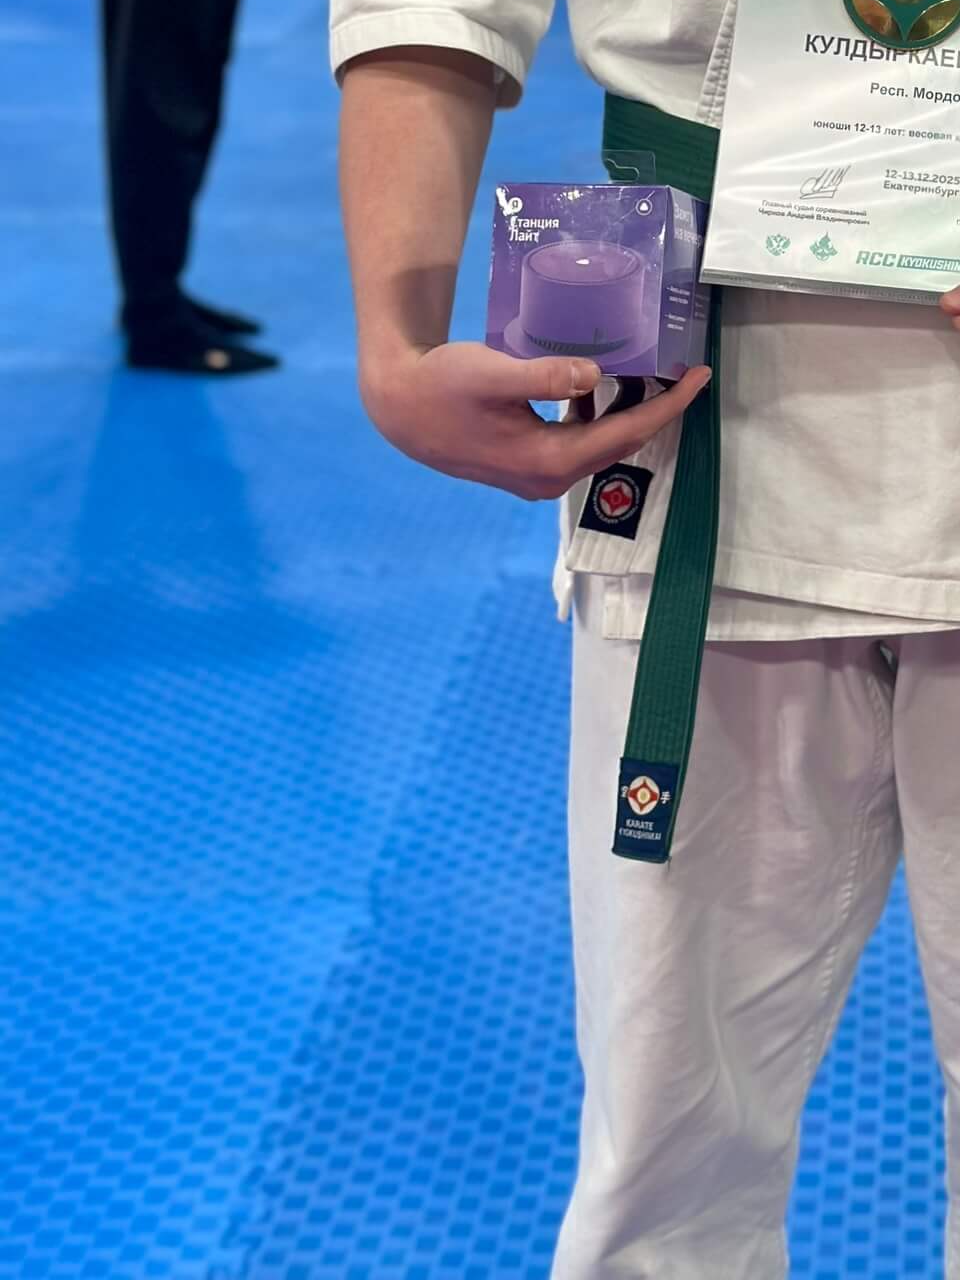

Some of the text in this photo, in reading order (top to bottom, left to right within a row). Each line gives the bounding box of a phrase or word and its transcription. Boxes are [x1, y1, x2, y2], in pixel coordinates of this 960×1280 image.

[870, 82, 909, 98] Респ.
[813, 120, 851, 132] юноши
[854, 122, 881, 135] 12-13
[884, 126, 905, 138] лет:
[908, 129, 952, 141] весовая
[884, 168, 960, 186] 12-13.12.2025
[883, 180, 960, 198] Екатеринбург
[510, 216, 560, 230] Станция
[509, 227, 540, 243] Лайт
[855, 251, 897, 268] RCC
